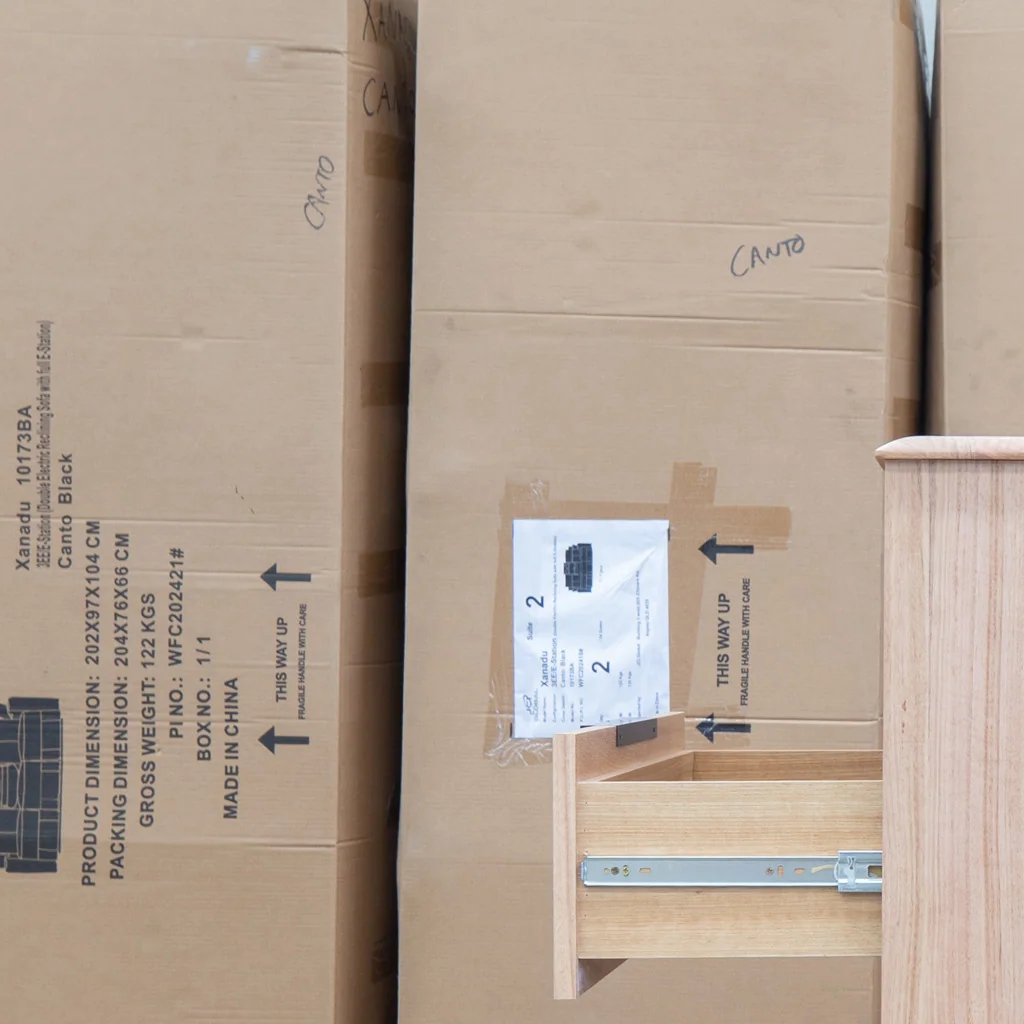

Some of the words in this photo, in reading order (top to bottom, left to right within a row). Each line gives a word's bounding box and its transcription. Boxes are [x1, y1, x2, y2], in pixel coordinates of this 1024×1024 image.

[730, 234, 806, 277] CANTO
[37, 393, 51, 412] Sofa
[16, 405, 32, 485] 10173BA
[37, 413, 53, 450] Reclining
[36, 451, 51, 481] Electric
[58, 453, 73, 504] Black
[15, 501, 31, 571] Xanadu
[58, 515, 72, 569] Canto
[85, 520, 100, 548] CM
[115, 533, 129, 561] CM
[168, 548, 184, 666] WFC202421#
[525, 595, 544, 608] 2
[718, 593, 731, 614] UP
[741, 578, 751, 603] CARE
[85, 554, 100, 665] 202X97X104
[114, 566, 129, 667] 204X76X66
[141, 593, 156, 632] KGS
[276, 616, 288, 636] UP
[299, 604, 307, 626] CARE
[741, 605, 750, 628] WITH
[298, 628, 306, 648] WITH
[526, 622, 534, 641] Suite
[717, 617, 730, 650] WAY
[740, 630, 750, 666] HANDLE
[141, 639, 156, 669] 122
[276, 639, 287, 669] WAY
[298, 650, 306, 683] HANDLE
[540, 650, 549, 687] Xanadu
[591, 661, 610, 673] 2
[716, 654, 730, 687] THIS
[169, 677, 183, 717] NO.:
[197, 677, 211, 717] NO.:
[275, 672, 287, 702] THIS
[298, 685, 306, 720] FRAGILE
[739, 667, 749, 706] FRAGILE
[141, 676, 156, 755] WEIGHT:
[224, 677, 239, 737] CHINA
[85, 675, 100, 789] DIMENSION:
[113, 675, 128, 789] DIMENSION:
[169, 721, 184, 739] PI
[197, 721, 211, 761] BOX
[224, 741, 239, 760] IN
[139, 760, 155, 828] GROSS
[223, 764, 239, 820] MADE
[82, 793, 99, 886] PRODUCT
[110, 794, 127, 880] PACKING
